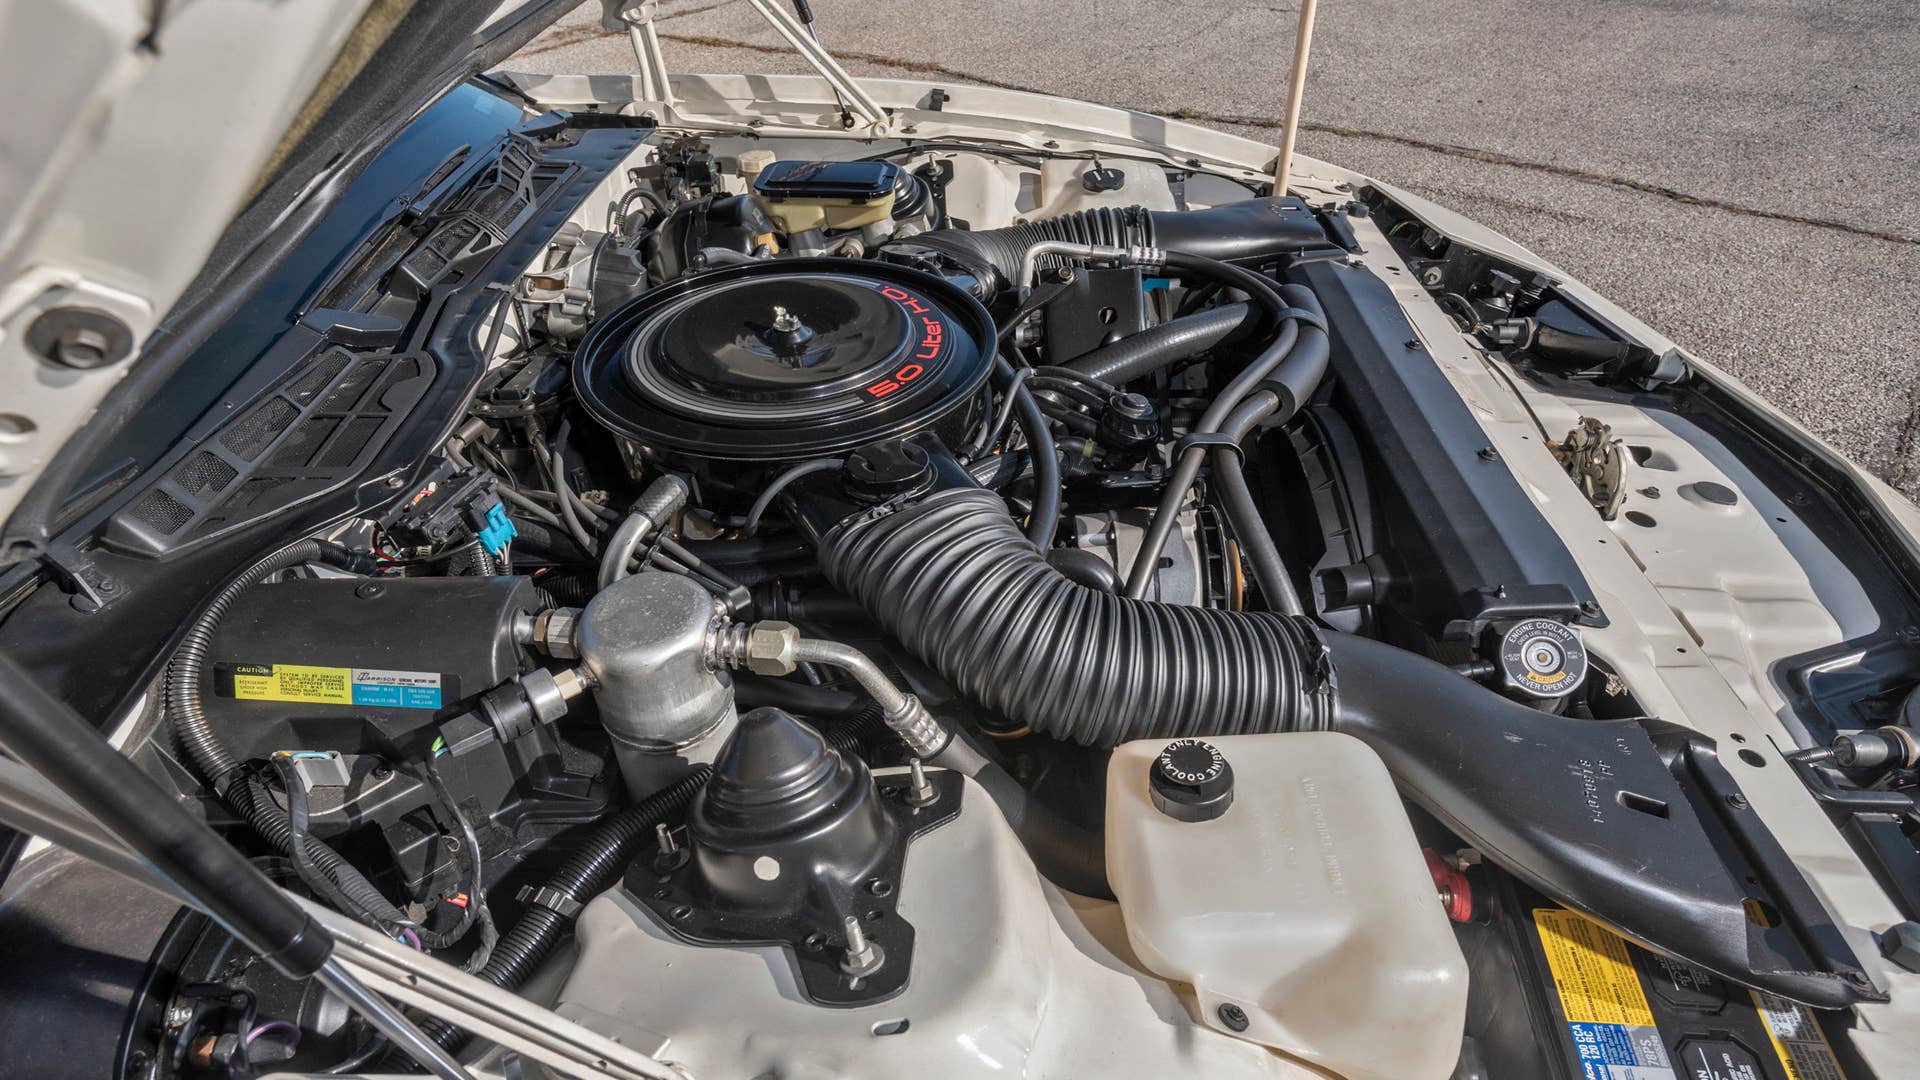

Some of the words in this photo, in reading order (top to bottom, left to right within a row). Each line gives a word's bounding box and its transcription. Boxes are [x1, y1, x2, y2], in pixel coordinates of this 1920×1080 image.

[881, 285, 931, 314] H.O.
[916, 316, 942, 359] Liter
[866, 364, 924, 398] 5.0
[1508, 622, 1534, 644] ENGINE
[1536, 622, 1574, 641] COOLANT
[236, 666, 269, 674] CAUTION
[1516, 673, 1541, 690] NEVER
[1542, 683, 1564, 692] OPEN
[1564, 671, 1577, 686] HOT
[1168, 739, 1201, 751] ONLY
[1161, 752, 1205, 781] COOLANT
[1202, 743, 1223, 776] ENGINE
[1572, 1024, 1585, 1042] CCA
[1584, 1031, 1596, 1042] RC
[1579, 1045, 1591, 1059] 700
[1589, 1045, 1601, 1059] 120
[1640, 1040, 1660, 1066] 78PS
